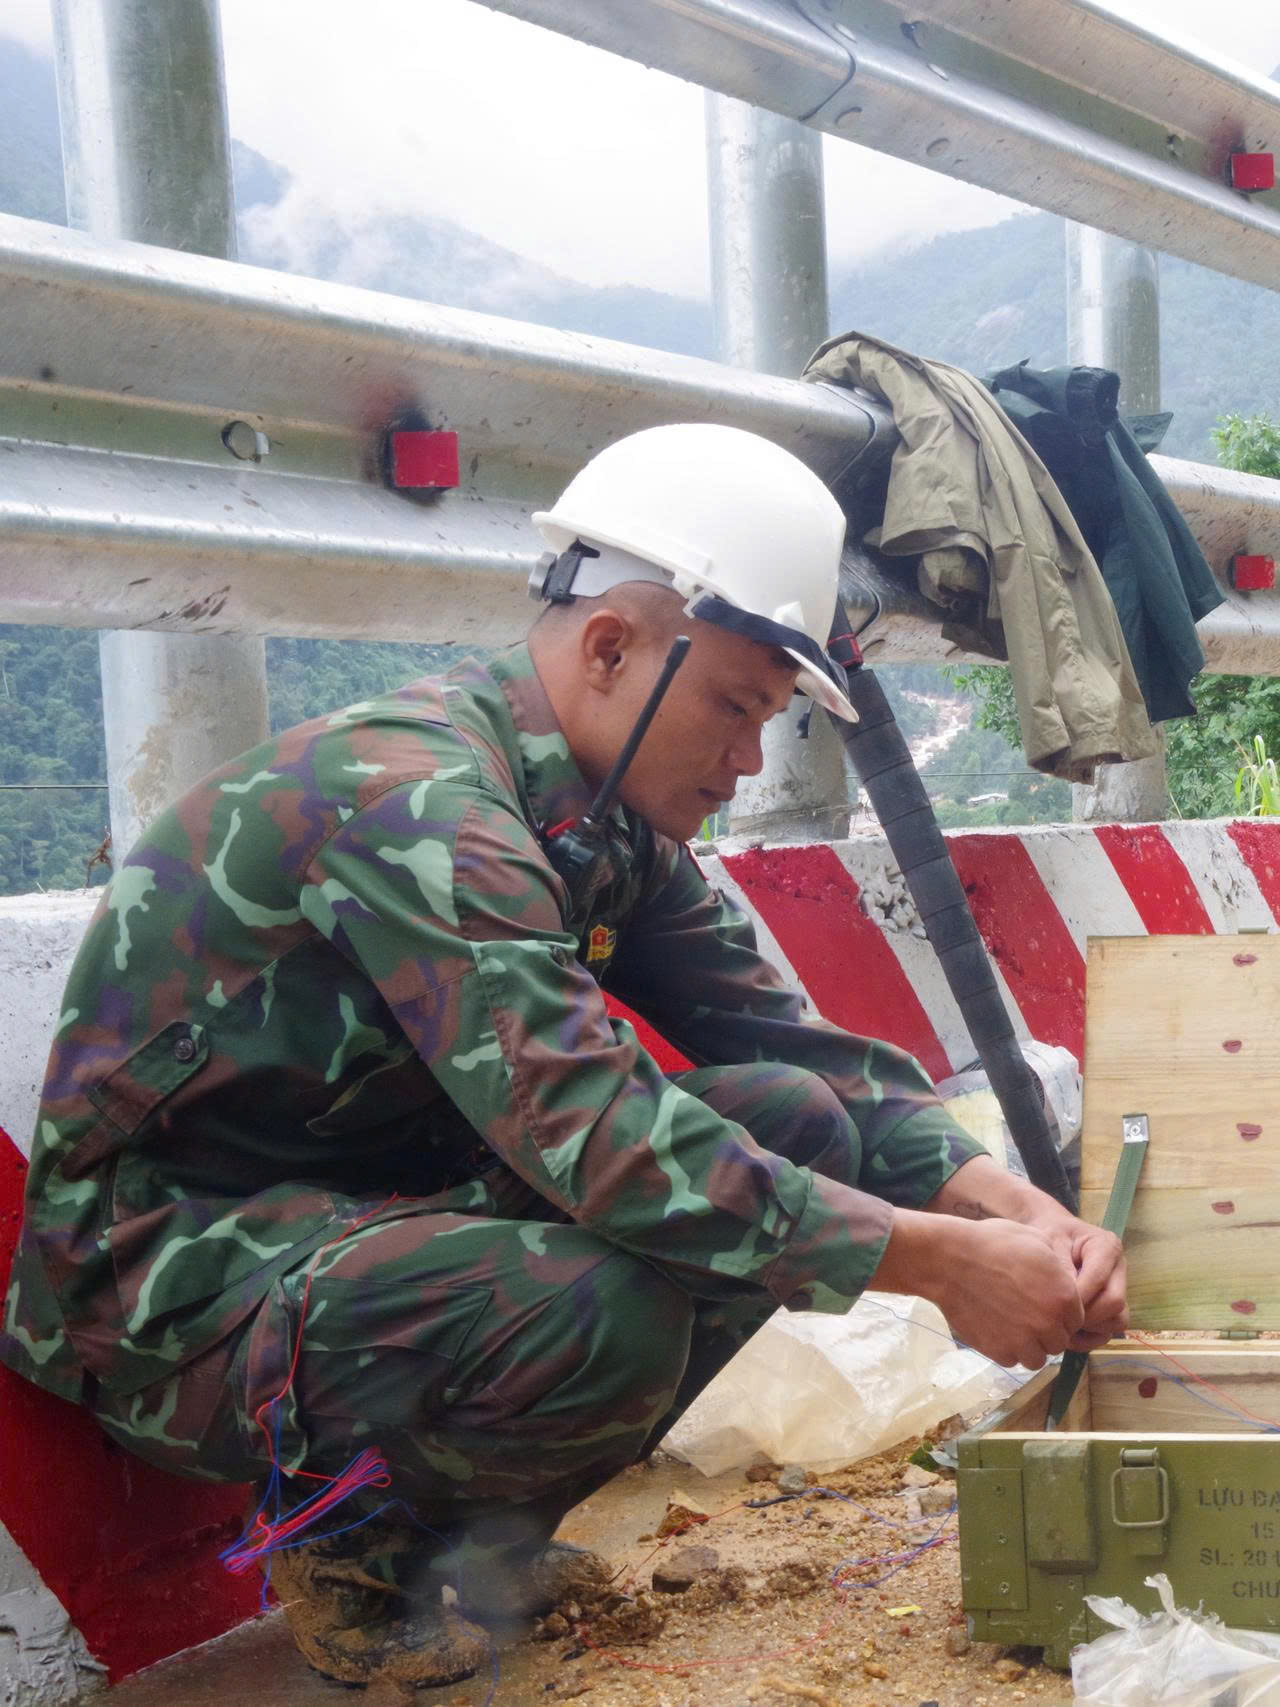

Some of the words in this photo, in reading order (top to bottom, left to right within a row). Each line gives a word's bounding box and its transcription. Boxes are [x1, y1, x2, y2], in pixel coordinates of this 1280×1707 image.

[1199, 1487, 1243, 1512] LỰU
[1251, 1521, 1275, 1540] 15
[1199, 1547, 1235, 1567] SL:
[1243, 1550, 1267, 1567] 20
